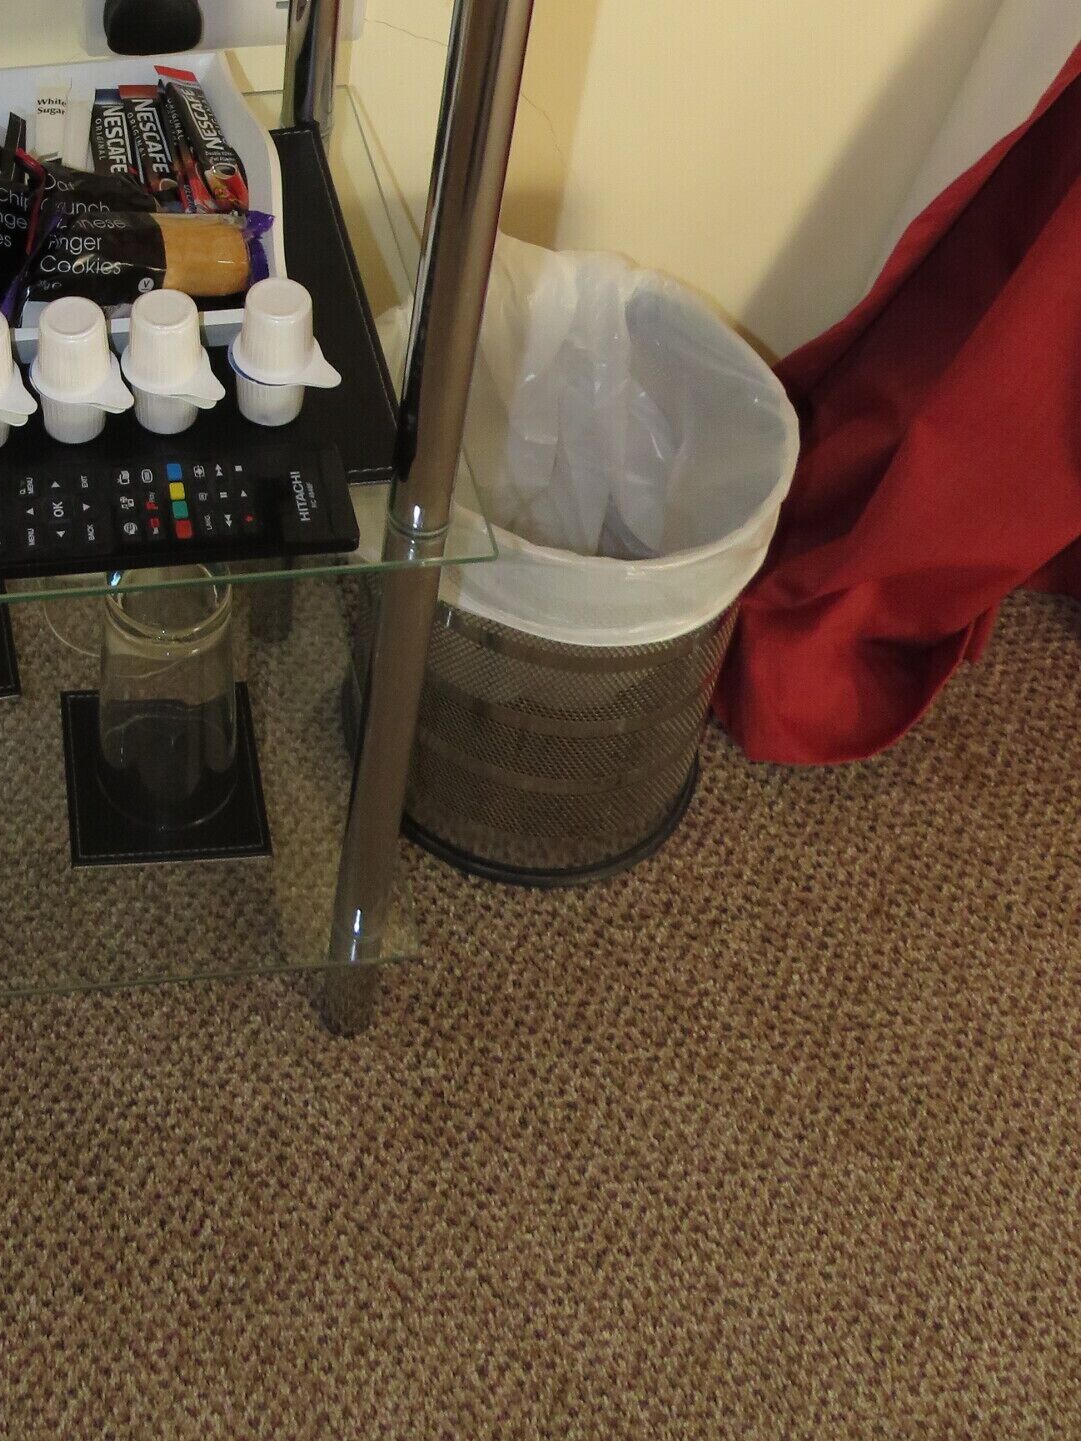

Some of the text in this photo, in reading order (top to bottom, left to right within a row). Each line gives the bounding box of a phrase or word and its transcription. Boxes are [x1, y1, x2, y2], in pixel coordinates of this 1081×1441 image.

[37, 98, 67, 108] White
[37, 107, 66, 116] Sugar
[95, 118, 107, 160] ORIGINAL
[127, 112, 146, 157] ORIGINAL
[40, 255, 122, 275] Cookies
[80, 475, 89, 488] EXIT
[290, 471, 311, 522] HITACHI
[52, 501, 65, 518] OK
[27, 528, 36, 546] MENU
[86, 524, 96, 542] BACK
